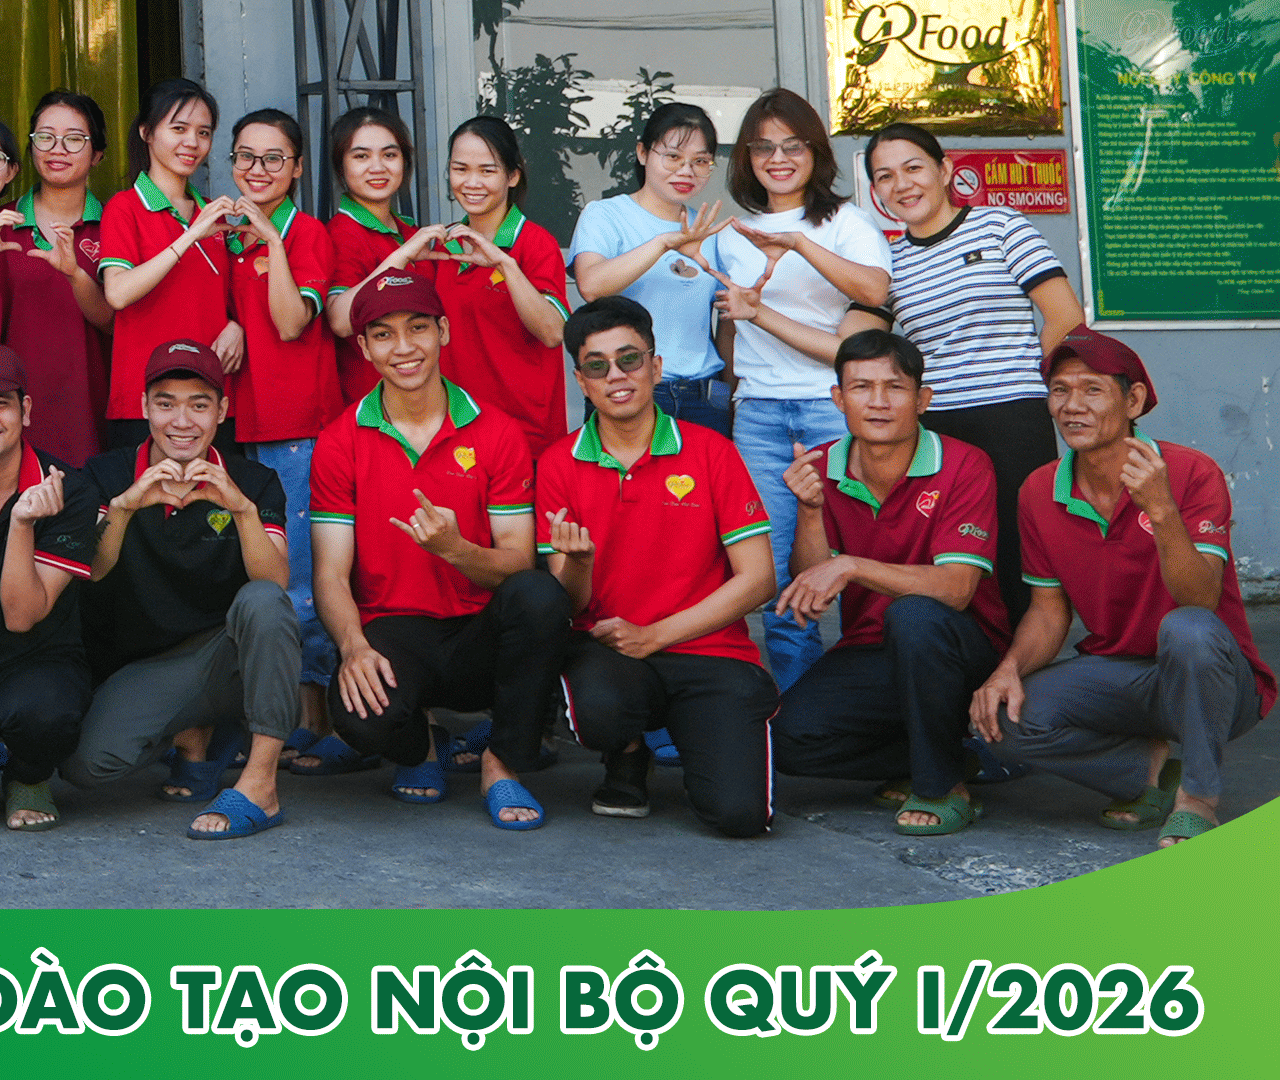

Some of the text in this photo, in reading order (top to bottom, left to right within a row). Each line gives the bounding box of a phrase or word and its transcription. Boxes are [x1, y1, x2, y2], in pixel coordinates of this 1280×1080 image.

[1238, 72, 1257, 85] TY
[985, 157, 1008, 185] CẤM
[987, 192, 1064, 207] NO SMOKING
